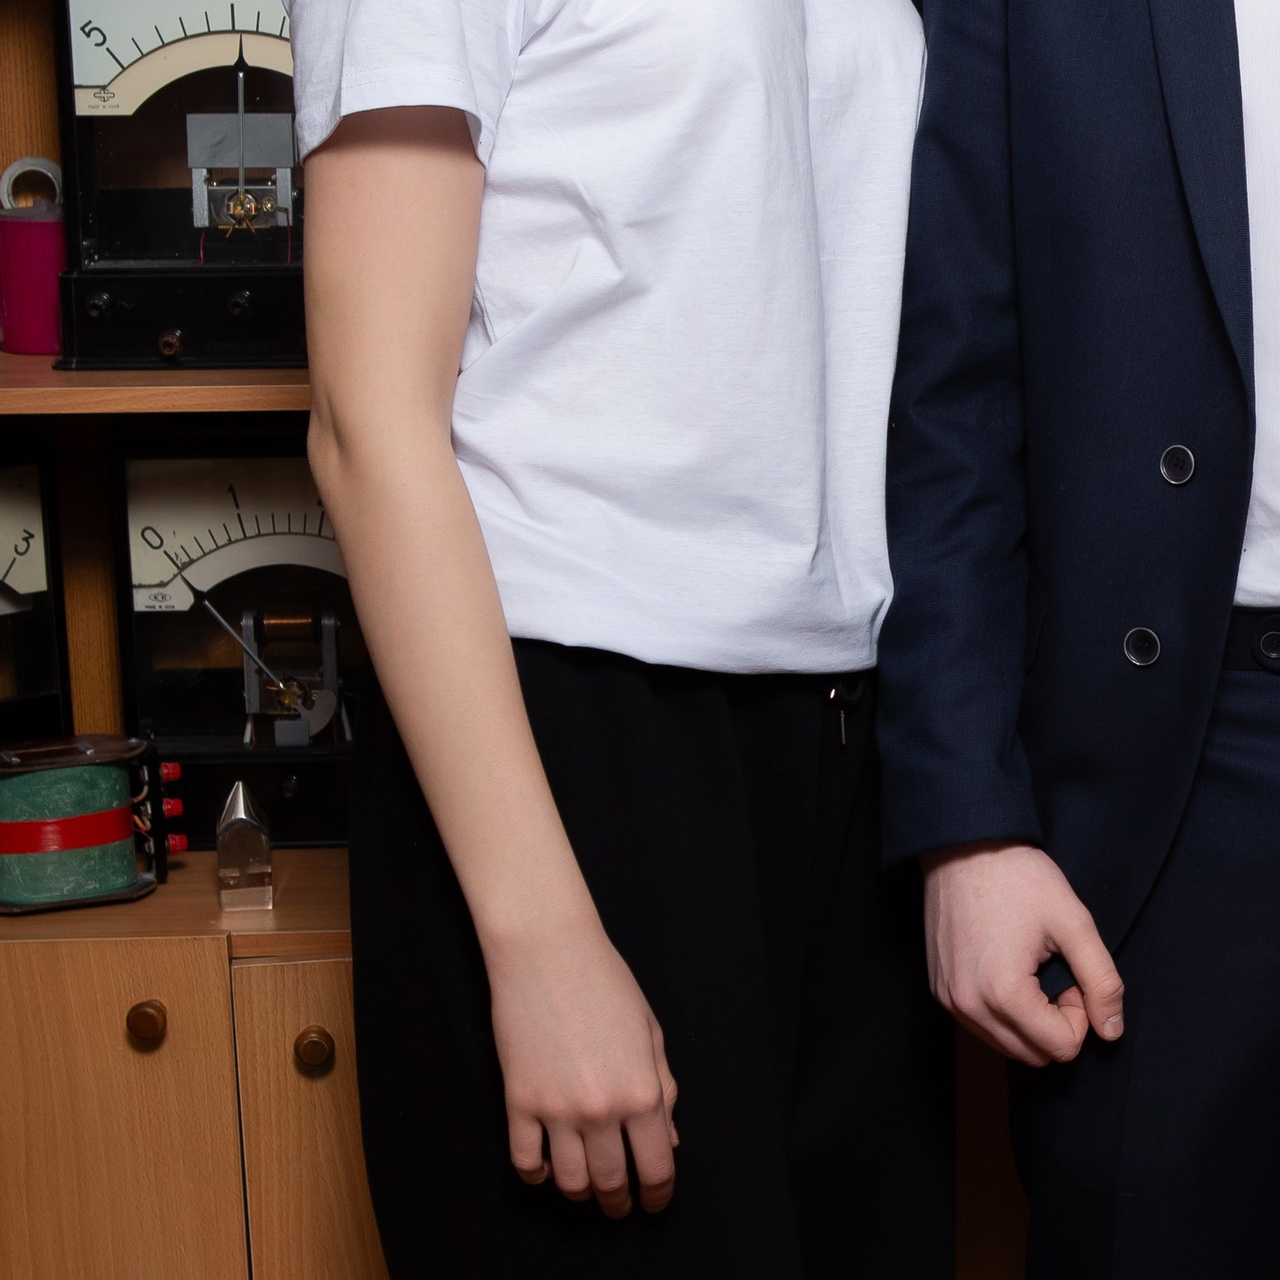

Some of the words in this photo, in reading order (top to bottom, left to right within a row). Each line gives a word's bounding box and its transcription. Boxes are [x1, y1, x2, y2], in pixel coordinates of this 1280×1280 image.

[79, 20, 107, 47] 5
[227, 483, 240, 509] 1
[14, 528, 35, 556] 3
[140, 526, 164, 550] 0
